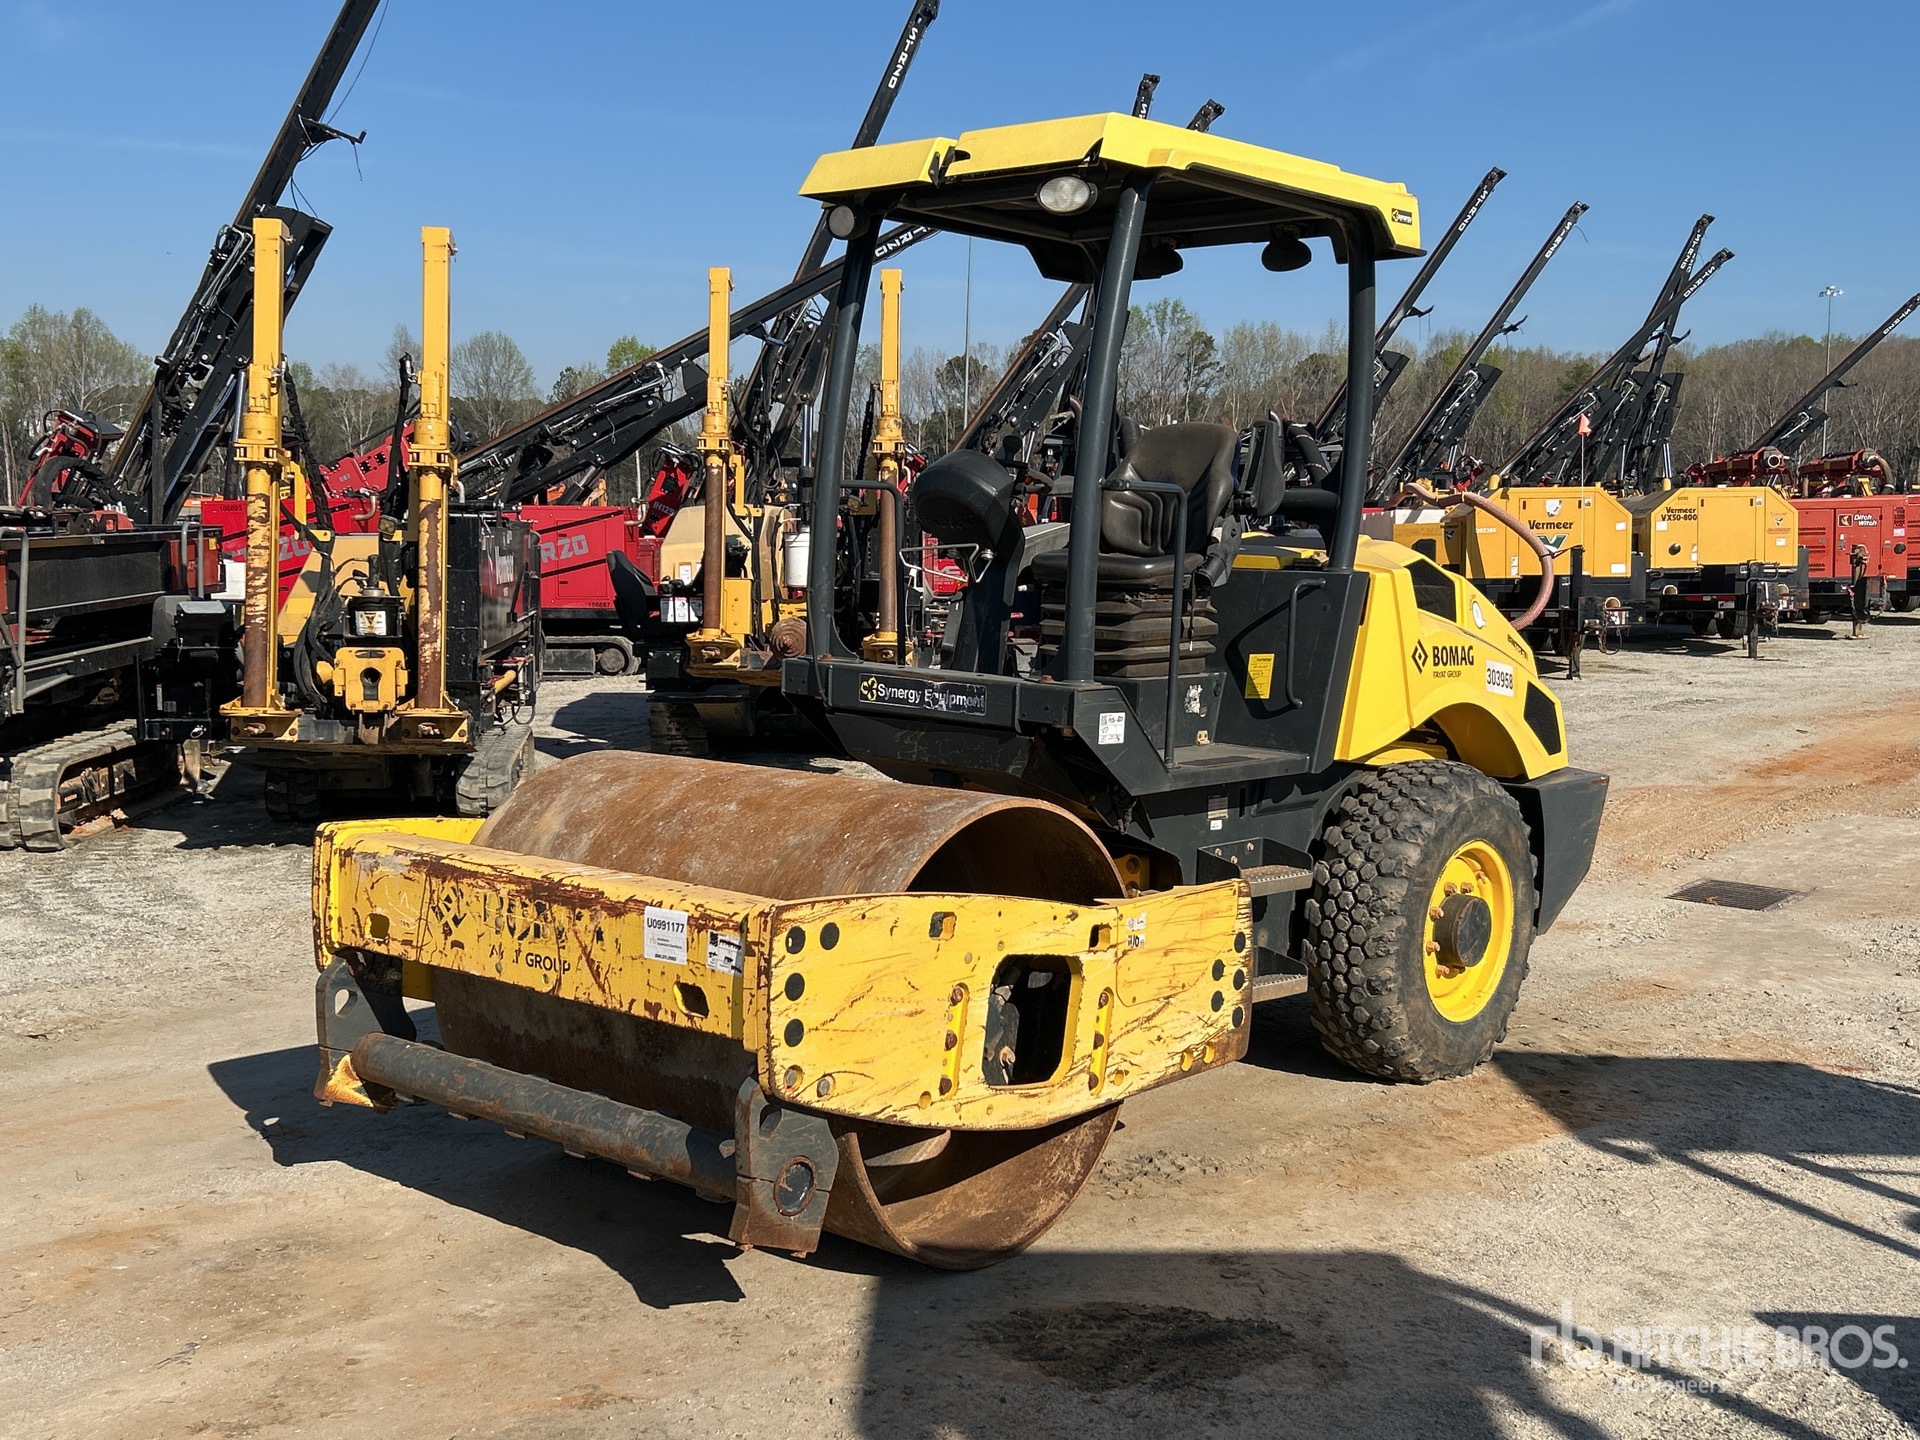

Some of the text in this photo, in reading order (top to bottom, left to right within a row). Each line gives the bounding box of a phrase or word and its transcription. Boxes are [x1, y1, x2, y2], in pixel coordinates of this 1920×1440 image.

[874, 226, 930, 258] TR20
[1528, 520, 1574, 530] Vermeer
[1854, 513, 1873, 521] Ditch
[1432, 645, 1475, 667] BOMAG
[1486, 668, 1514, 690] 303958
[878, 683, 922, 703] Synergy
[647, 917, 685, 934] U0991177
[525, 952, 571, 975] GROUP
